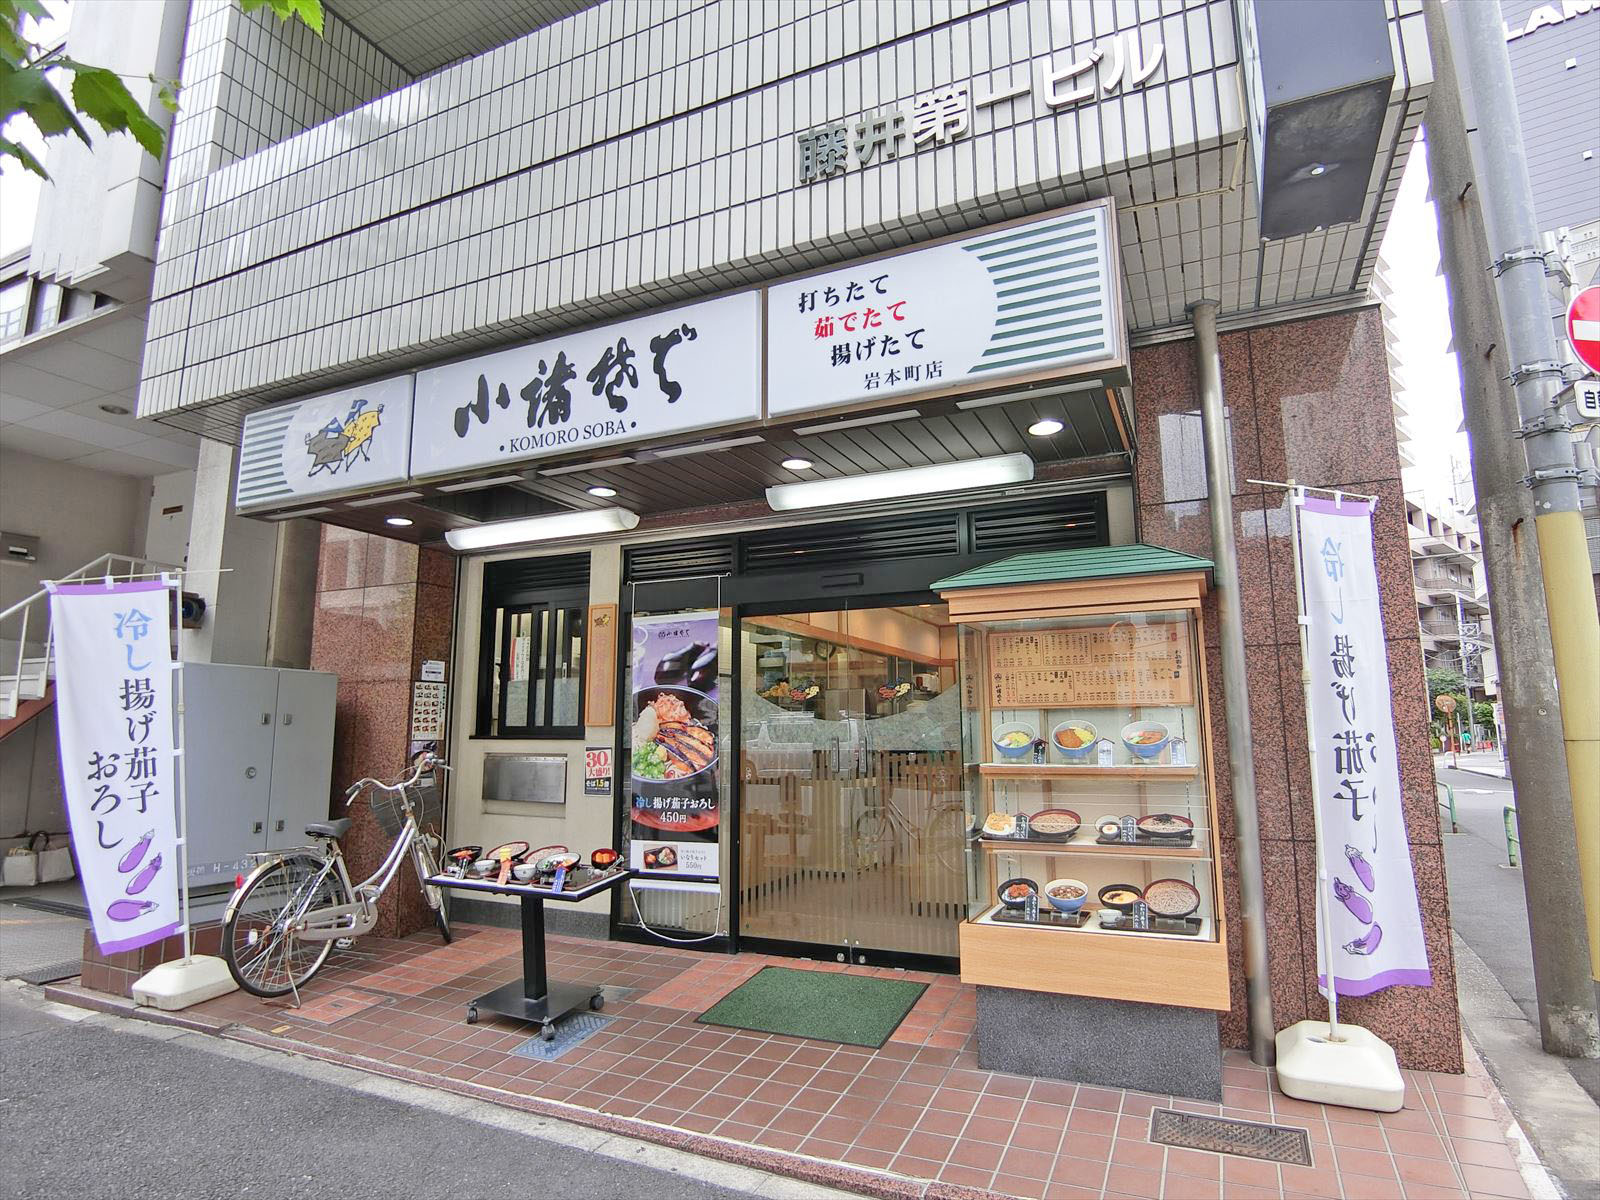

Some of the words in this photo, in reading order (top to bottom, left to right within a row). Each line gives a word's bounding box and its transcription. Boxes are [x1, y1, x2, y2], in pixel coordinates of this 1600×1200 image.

[798, 30, 1165, 184] 藤井第一ビル
[798, 274, 889, 313] 打ちたて
[814, 301, 907, 341] 茹でたて
[830, 328, 926, 367] 揚げたて
[863, 360, 944, 391] 岩本町店
[1584, 389, 1600, 409] 自
[509, 426, 579, 454] KOMORO
[583, 421, 627, 443] SOBA
[113, 607, 160, 815] 冷し揚げ茄子
[586, 751, 608, 768] 30
[87, 750, 124, 850] おろし
[636, 796, 716, 810] 冷し揚げ茄子おろし
[660, 811, 688, 823] 450円
